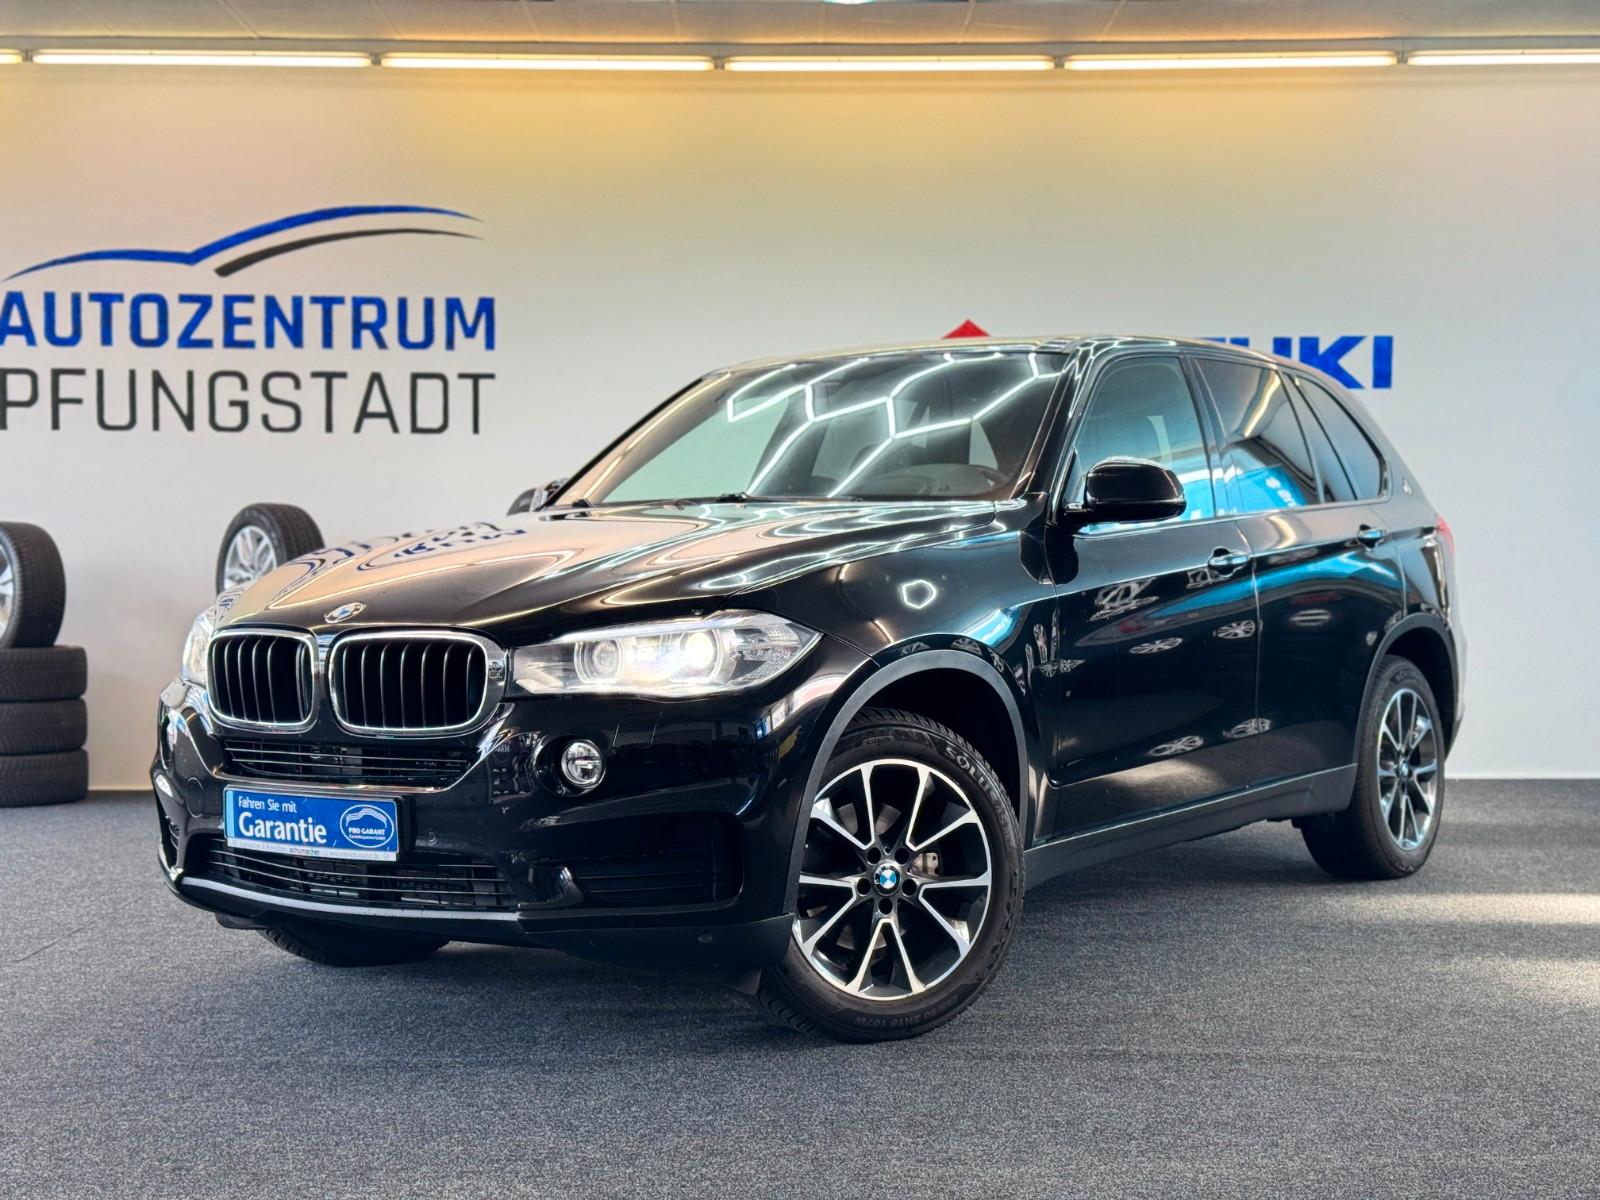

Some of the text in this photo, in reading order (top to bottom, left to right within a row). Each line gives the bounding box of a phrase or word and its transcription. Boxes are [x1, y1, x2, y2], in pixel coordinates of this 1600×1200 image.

[0, 291, 496, 351] AUTOZENTRUM
[0, 367, 496, 434] PFUNGSTADT
[238, 795, 298, 813] Fahren Sie mit
[238, 811, 328, 844] Garantie
[348, 827, 386, 836] PRO GARANT
